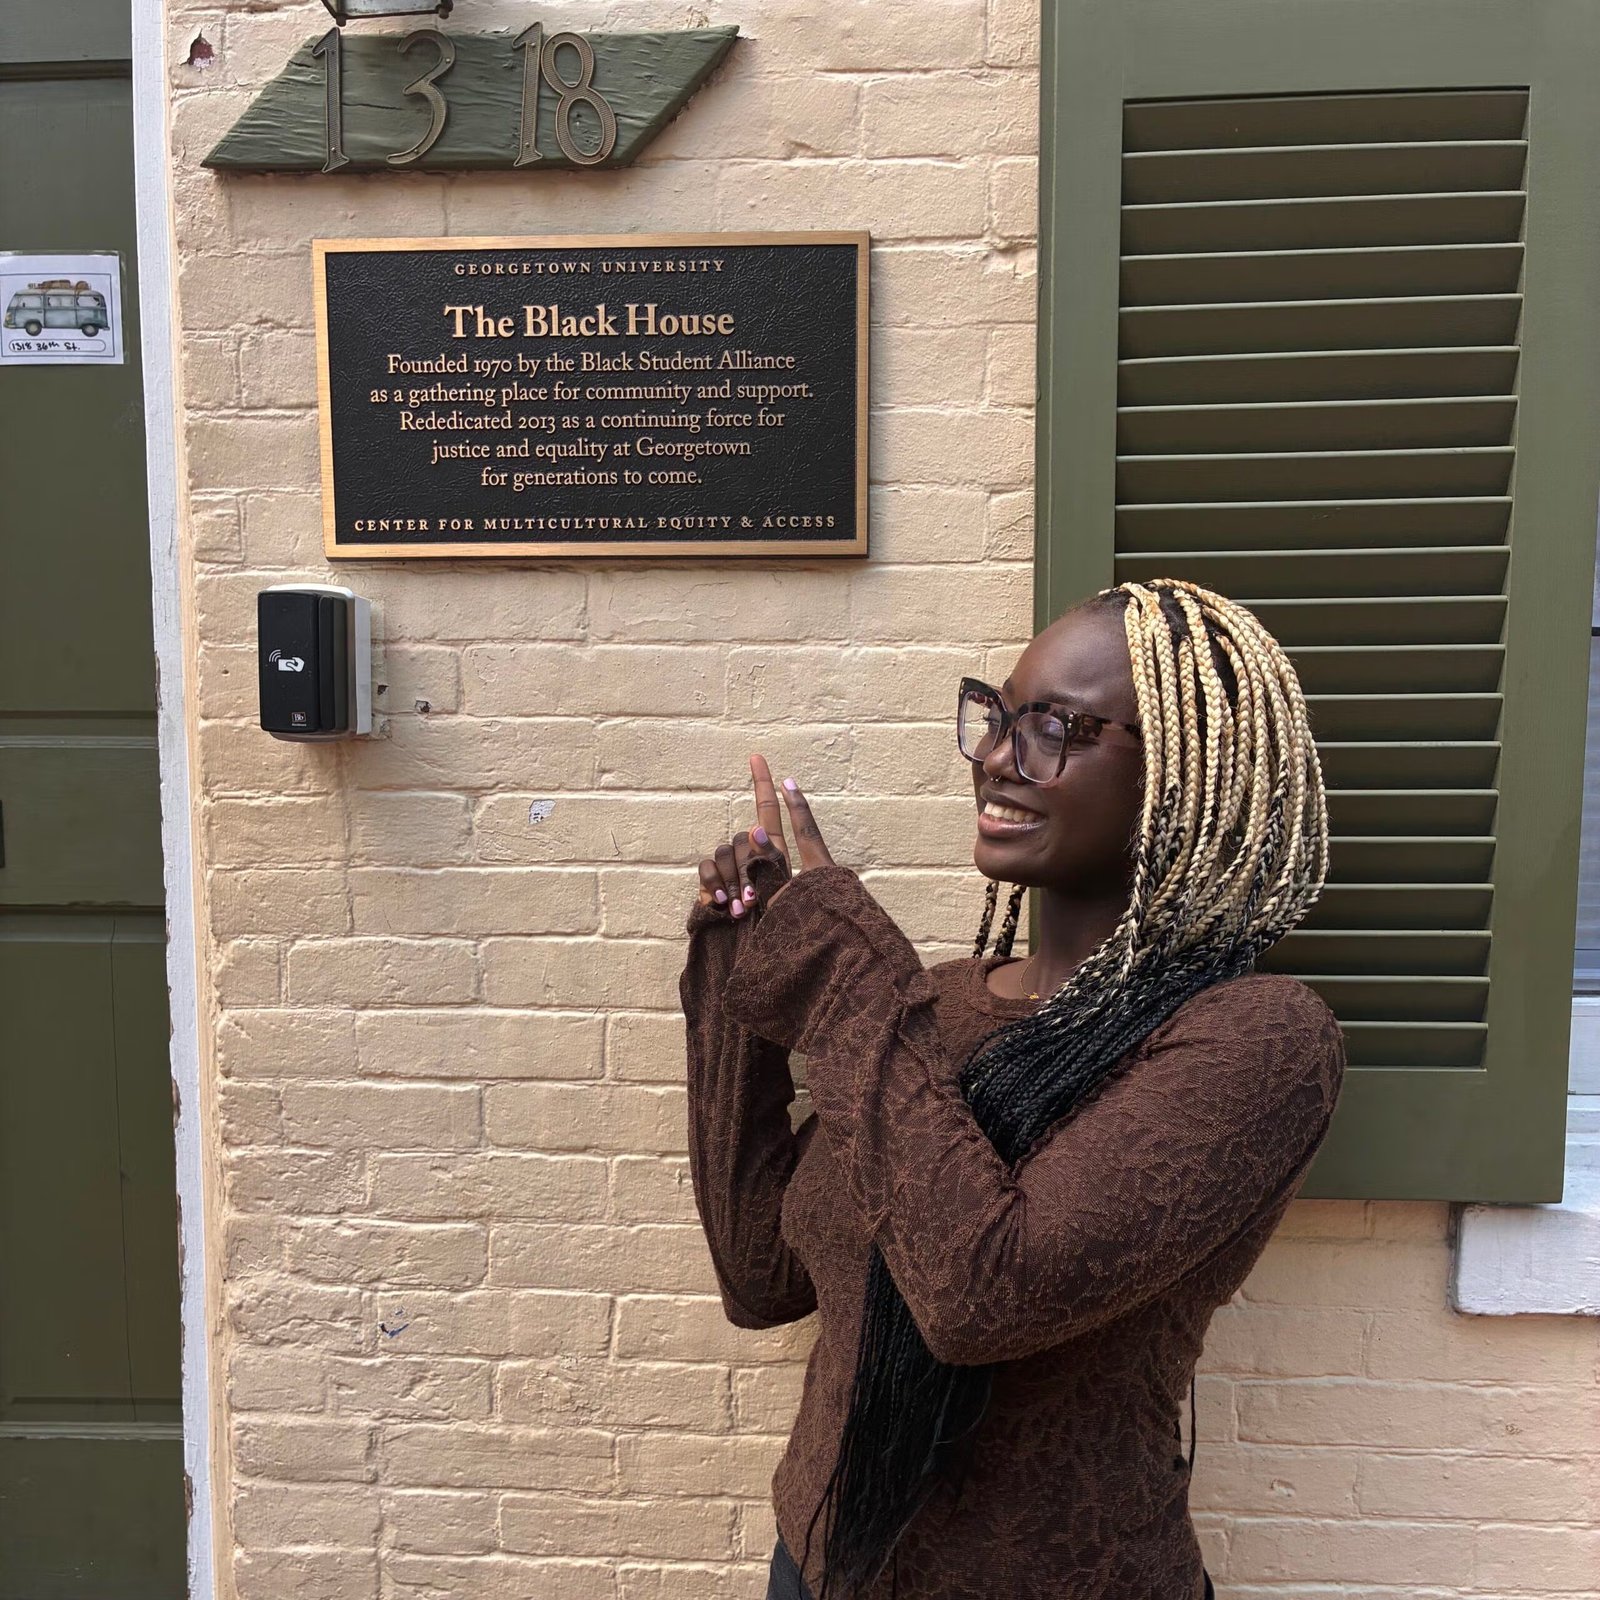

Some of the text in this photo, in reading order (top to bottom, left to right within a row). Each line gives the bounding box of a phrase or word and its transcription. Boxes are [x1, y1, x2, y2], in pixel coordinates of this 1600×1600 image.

[311, 21, 617, 173] 1318
[454, 260, 725, 275] GEORGETOWN UNIVERSITY
[443, 302, 735, 338] The Black House
[11, 341, 81, 351] 1318 36th St.
[386, 349, 796, 378] Founded 1970 by the Black Student Alliance
[370, 378, 814, 409] as a gathering place for community and support.
[399, 406, 786, 434] Rededicated 2013 as a continuing force for
[430, 436, 752, 465] justice and equality at Georgetown
[480, 466, 702, 492] for generations to come.
[354, 515, 835, 532] CENTER FOR MULTICULTURAL EQUITY & ACCESS
